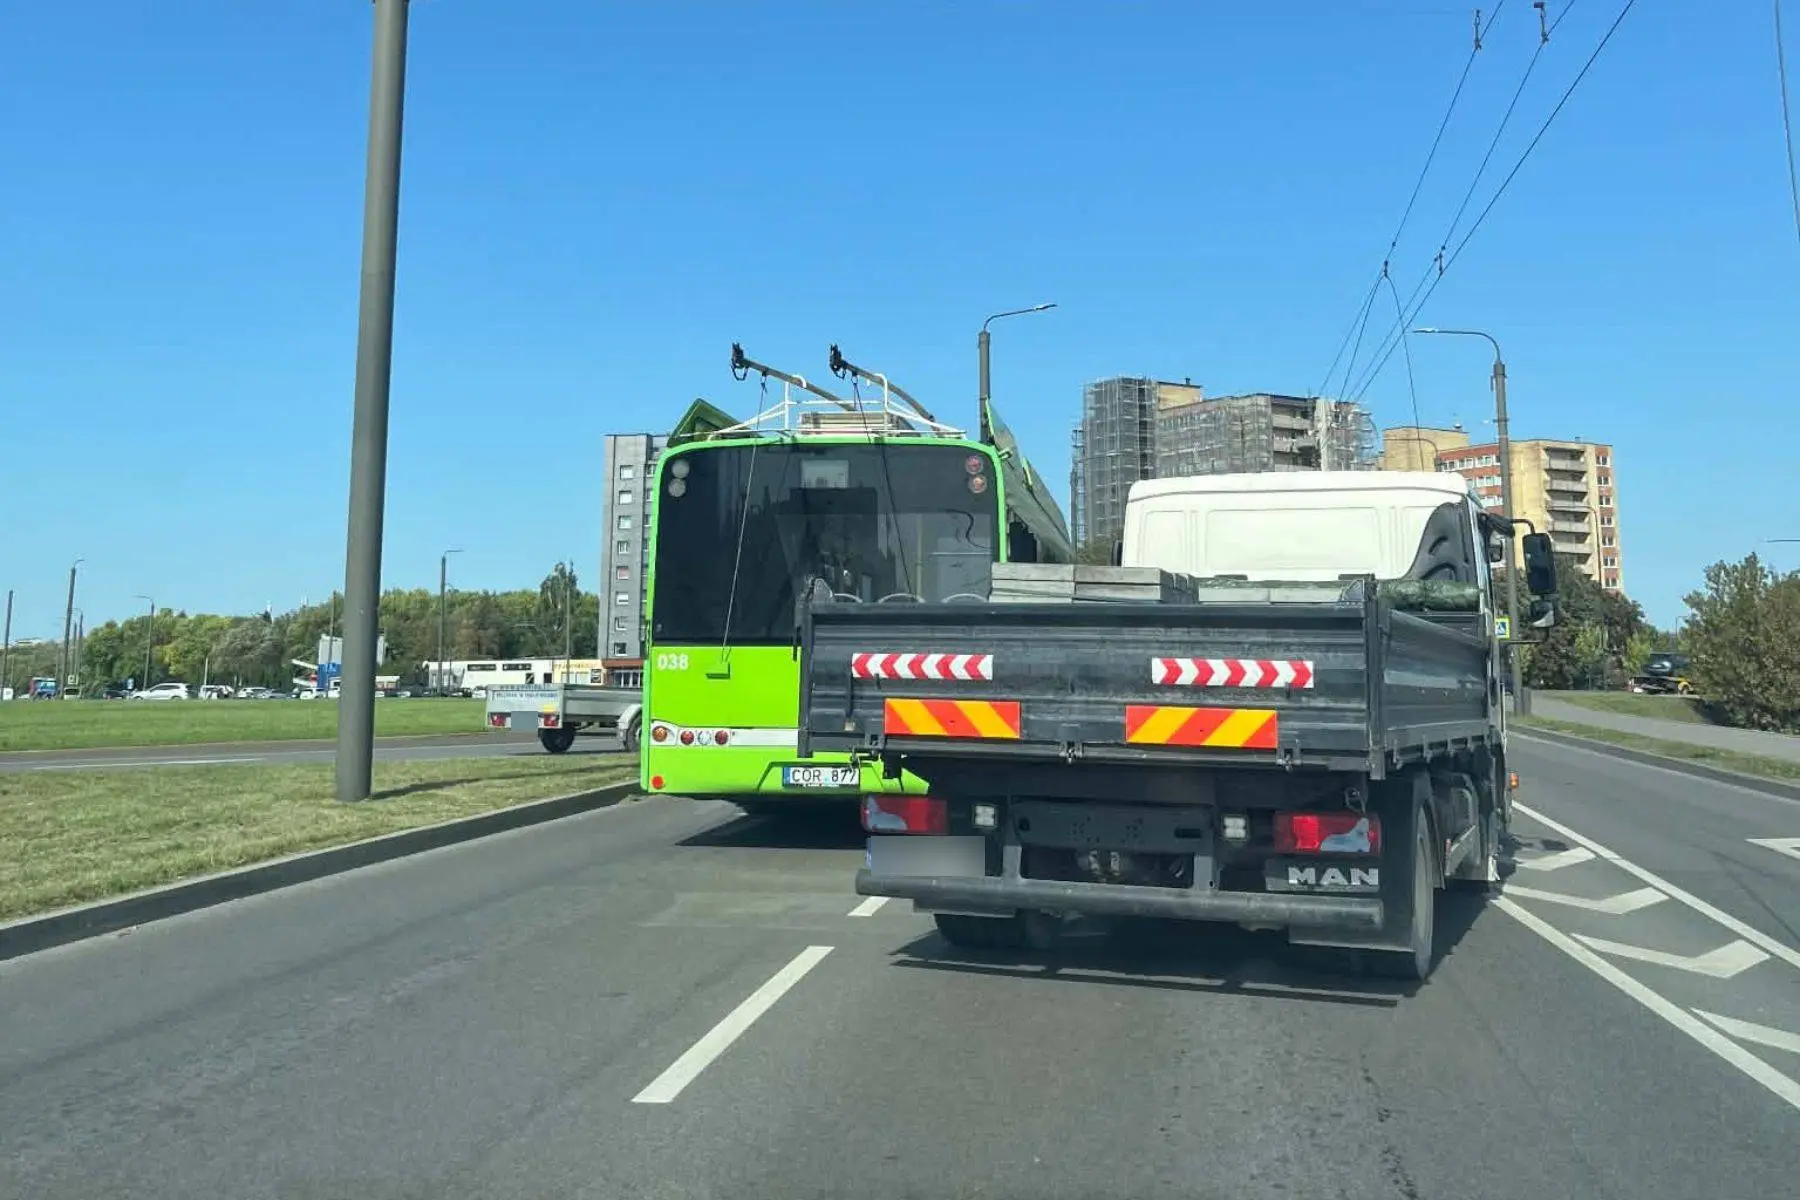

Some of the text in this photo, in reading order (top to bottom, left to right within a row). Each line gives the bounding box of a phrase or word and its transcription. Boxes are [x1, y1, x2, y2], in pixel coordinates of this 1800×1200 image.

[657, 653, 689, 670] 038
[792, 769, 856, 782] COR 877
[1288, 867, 1379, 885] MAN
